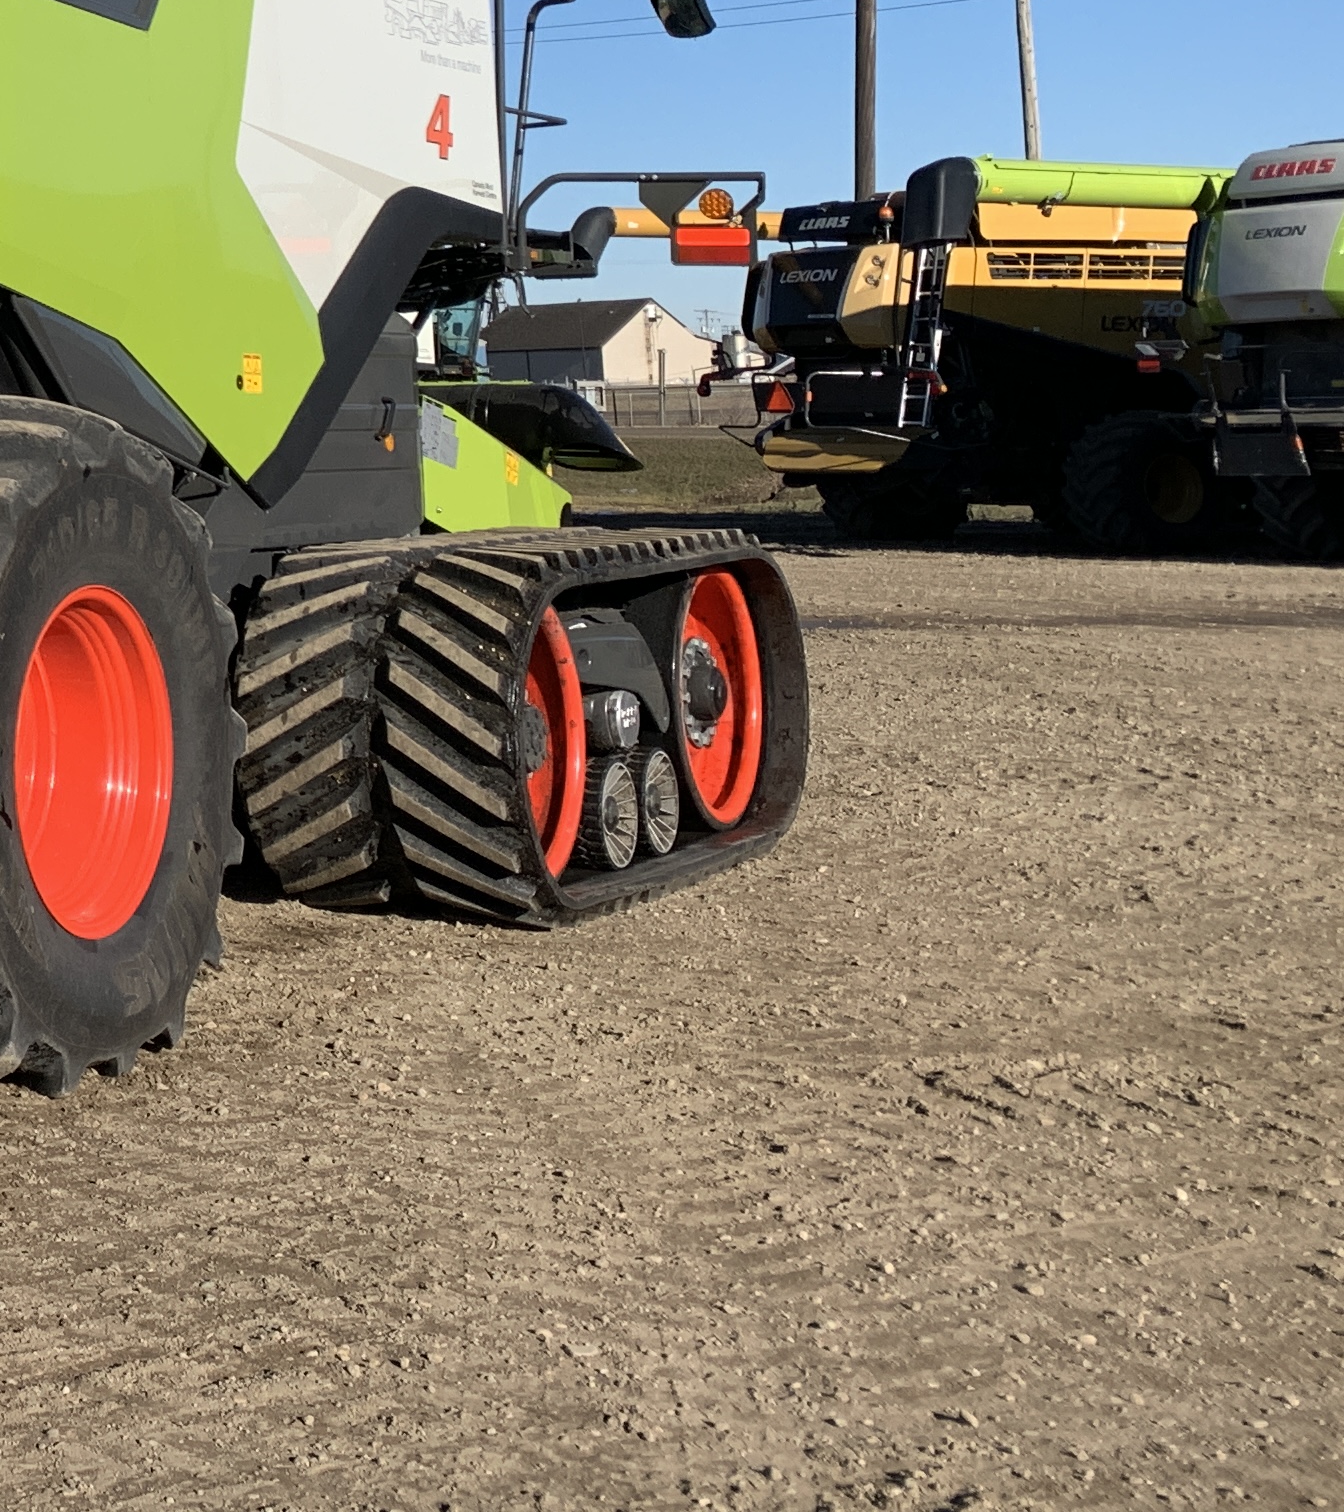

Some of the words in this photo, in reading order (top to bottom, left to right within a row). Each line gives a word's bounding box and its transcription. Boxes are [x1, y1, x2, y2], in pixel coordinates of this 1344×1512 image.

[426, 93, 454, 160] 4
[1249, 158, 1337, 181] CLAAS
[798, 215, 851, 231] CLAAS
[1245, 225, 1307, 241] LEXION
[779, 268, 839, 284] LEXION
[1142, 299, 1188, 318] 760
